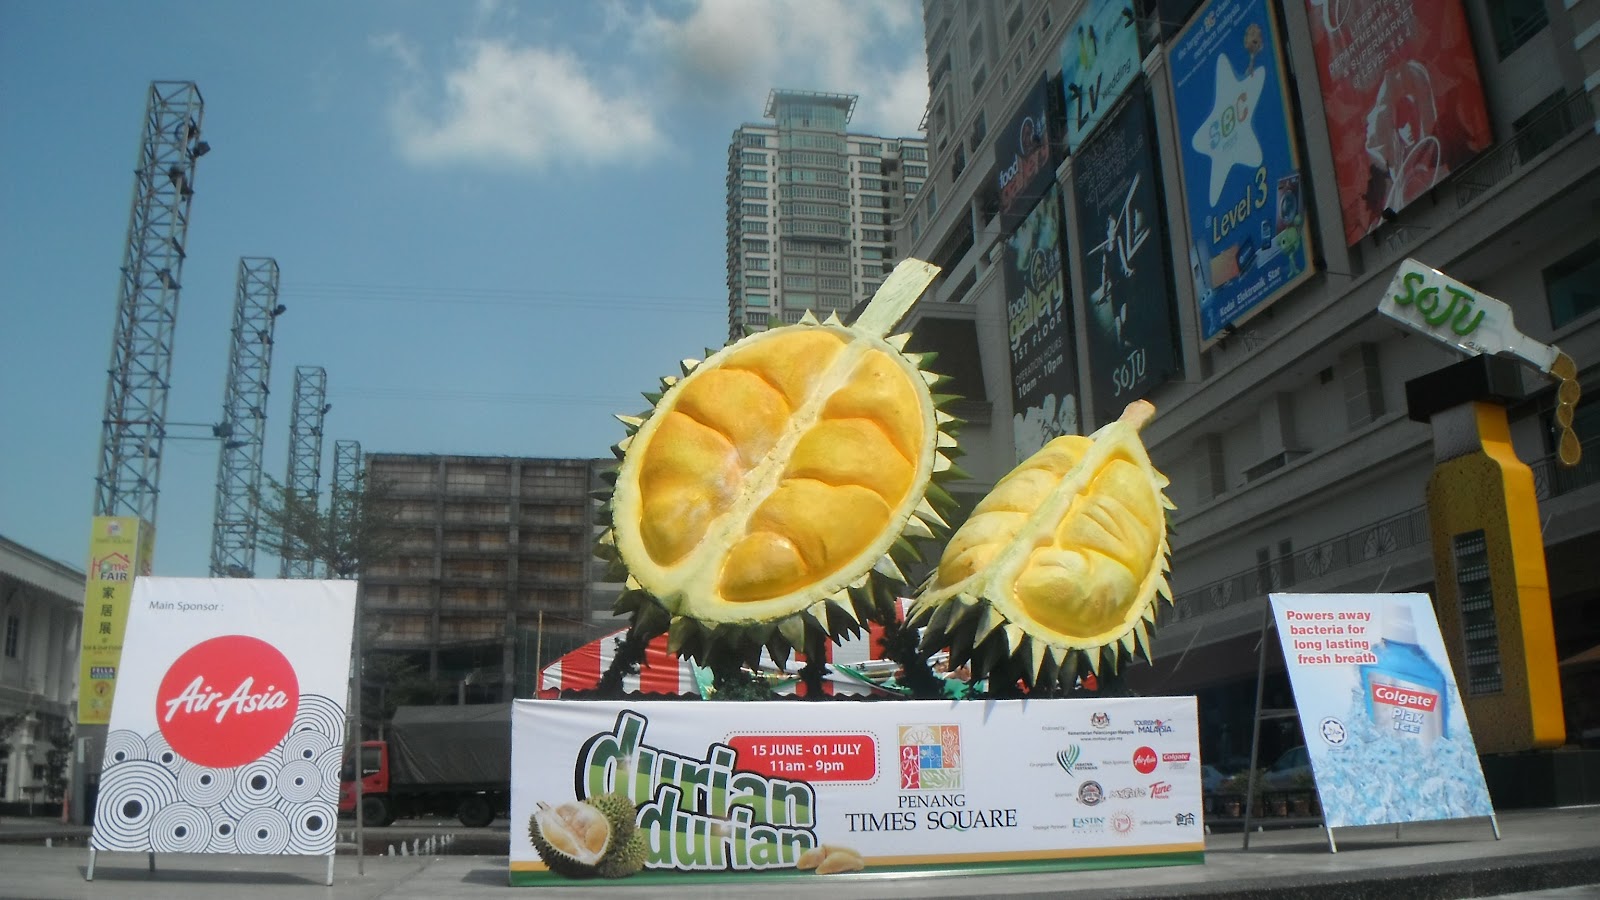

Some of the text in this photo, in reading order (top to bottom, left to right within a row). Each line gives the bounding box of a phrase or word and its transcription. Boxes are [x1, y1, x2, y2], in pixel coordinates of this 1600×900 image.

[1328, 8, 1393, 73] DEPARTMENTAL
[1351, 3, 1414, 71] SUPERMARKET
[1360, 49, 1390, 78] LEVEL
[999, 153, 1019, 189] food
[1213, 185, 1252, 244] Level
[1254, 165, 1269, 210] 3
[1008, 286, 1028, 322] food
[1009, 275, 1064, 352] gallery
[1014, 315, 1063, 364] 1ST FLOOR
[1018, 377, 1037, 400] 10am
[1043, 353, 1064, 378] 10pm
[101, 572, 128, 581] FAIR
[149, 600, 174, 611] Main
[177, 601, 218, 613] Sponsor
[1286, 610, 1371, 622] Powers away
[1290, 624, 1365, 635] bacteria for
[1294, 639, 1369, 652] long lasting
[1297, 653, 1377, 664] fresh breath
[1375, 687, 1432, 708] Colgate
[1391, 707, 1424, 724] Plax
[1138, 724, 1173, 736] MALAYSIA
[751, 744, 766, 756] 15
[769, 744, 803, 756] JUNE
[813, 744, 828, 756] 01
[829, 743, 862, 756] JULY
[1163, 753, 1189, 761] Colgate
[575, 710, 816, 826] durian
[770, 760, 805, 772] 11am
[815, 760, 845, 774] 9pm
[1149, 781, 1173, 798] Tune
[897, 793, 966, 809] PENANG
[636, 784, 817, 871] durian
[845, 809, 1018, 833] TIMES SQUARE
[1073, 817, 1104, 828] EASTIN
